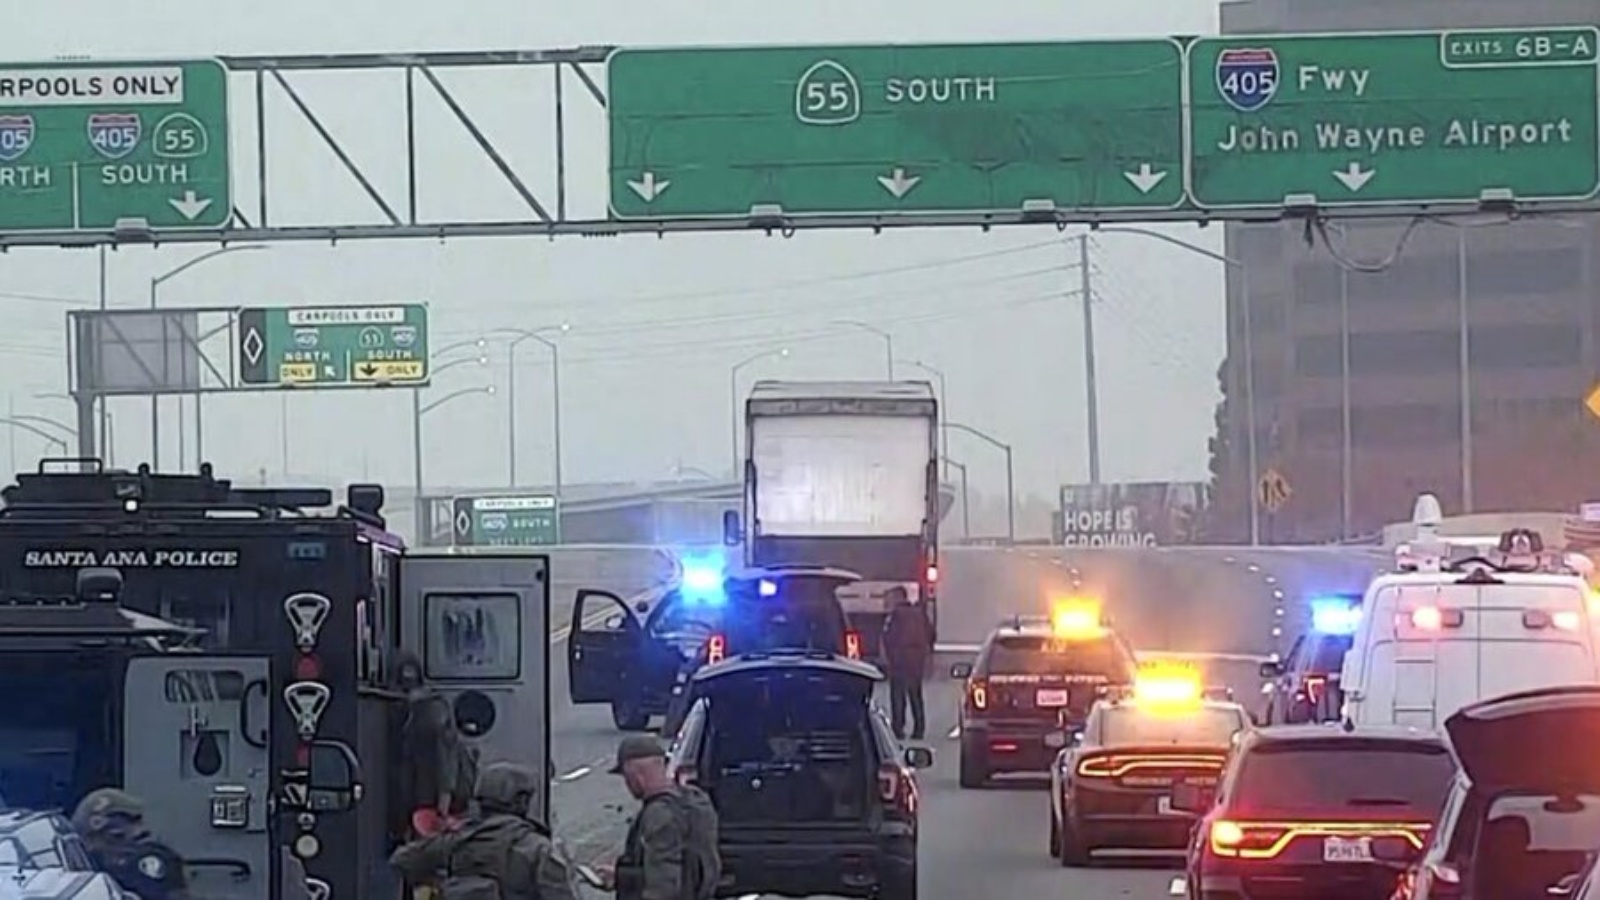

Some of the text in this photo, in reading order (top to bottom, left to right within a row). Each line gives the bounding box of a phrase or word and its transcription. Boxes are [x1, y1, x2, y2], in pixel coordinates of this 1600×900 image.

[1451, 35, 1590, 57] EXITS 6B-A
[113, 75, 179, 96] ONLY
[1222, 66, 1370, 96] 405 Fwy
[806, 77, 995, 111] 55 SOUTH
[95, 128, 195, 150] 405 55
[1218, 118, 1572, 154] John Wayne Airport
[102, 163, 188, 185] SOUTH
[285, 350, 331, 361] NORTH
[367, 349, 413, 360] SOUTH
[282, 367, 314, 378] ONLY
[386, 364, 419, 376] ONLY
[1064, 508, 1133, 532] HOPE IS
[1064, 532, 1158, 549] GROWING
[25, 551, 239, 567] SANTA ANA POLICE
